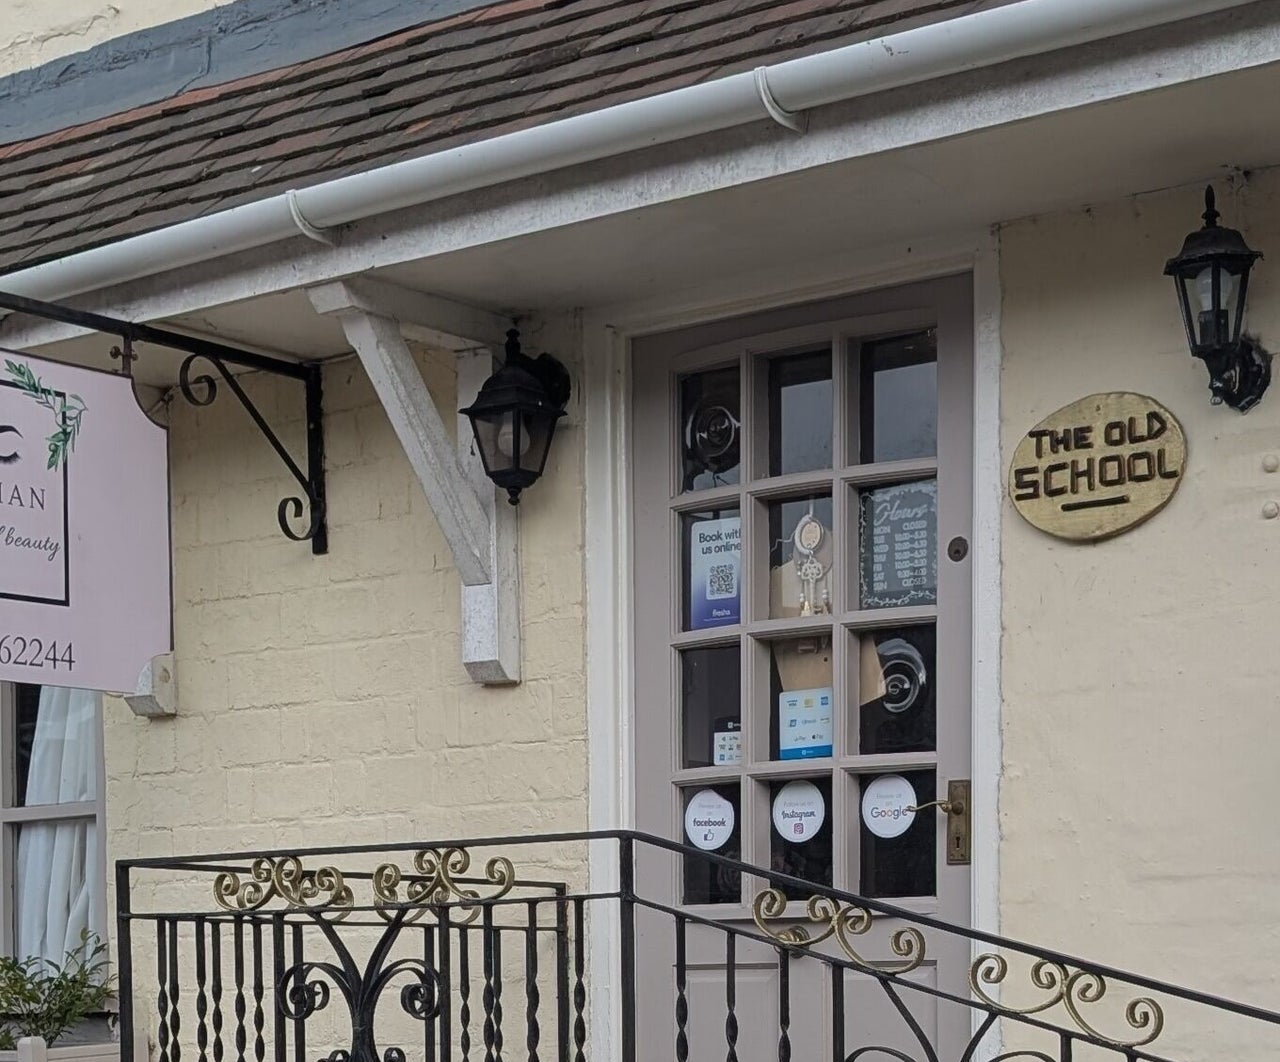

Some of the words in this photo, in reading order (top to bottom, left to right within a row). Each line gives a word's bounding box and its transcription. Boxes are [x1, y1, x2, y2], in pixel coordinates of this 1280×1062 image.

[1028, 425, 1094, 459] THE
[1104, 410, 1168, 447] OLD
[1014, 448, 1180, 502] SCHOOL
[873, 500, 928, 526] Hours
[699, 530, 723, 544] Book
[5, 527, 61, 562] beauty
[702, 546, 713, 555] us
[714, 541, 741, 553] online
[902, 577, 927, 588] CLOSED
[781, 810, 816, 822] Instagram
[870, 805, 908, 820] Google
[693, 817, 726, 827] facebook
